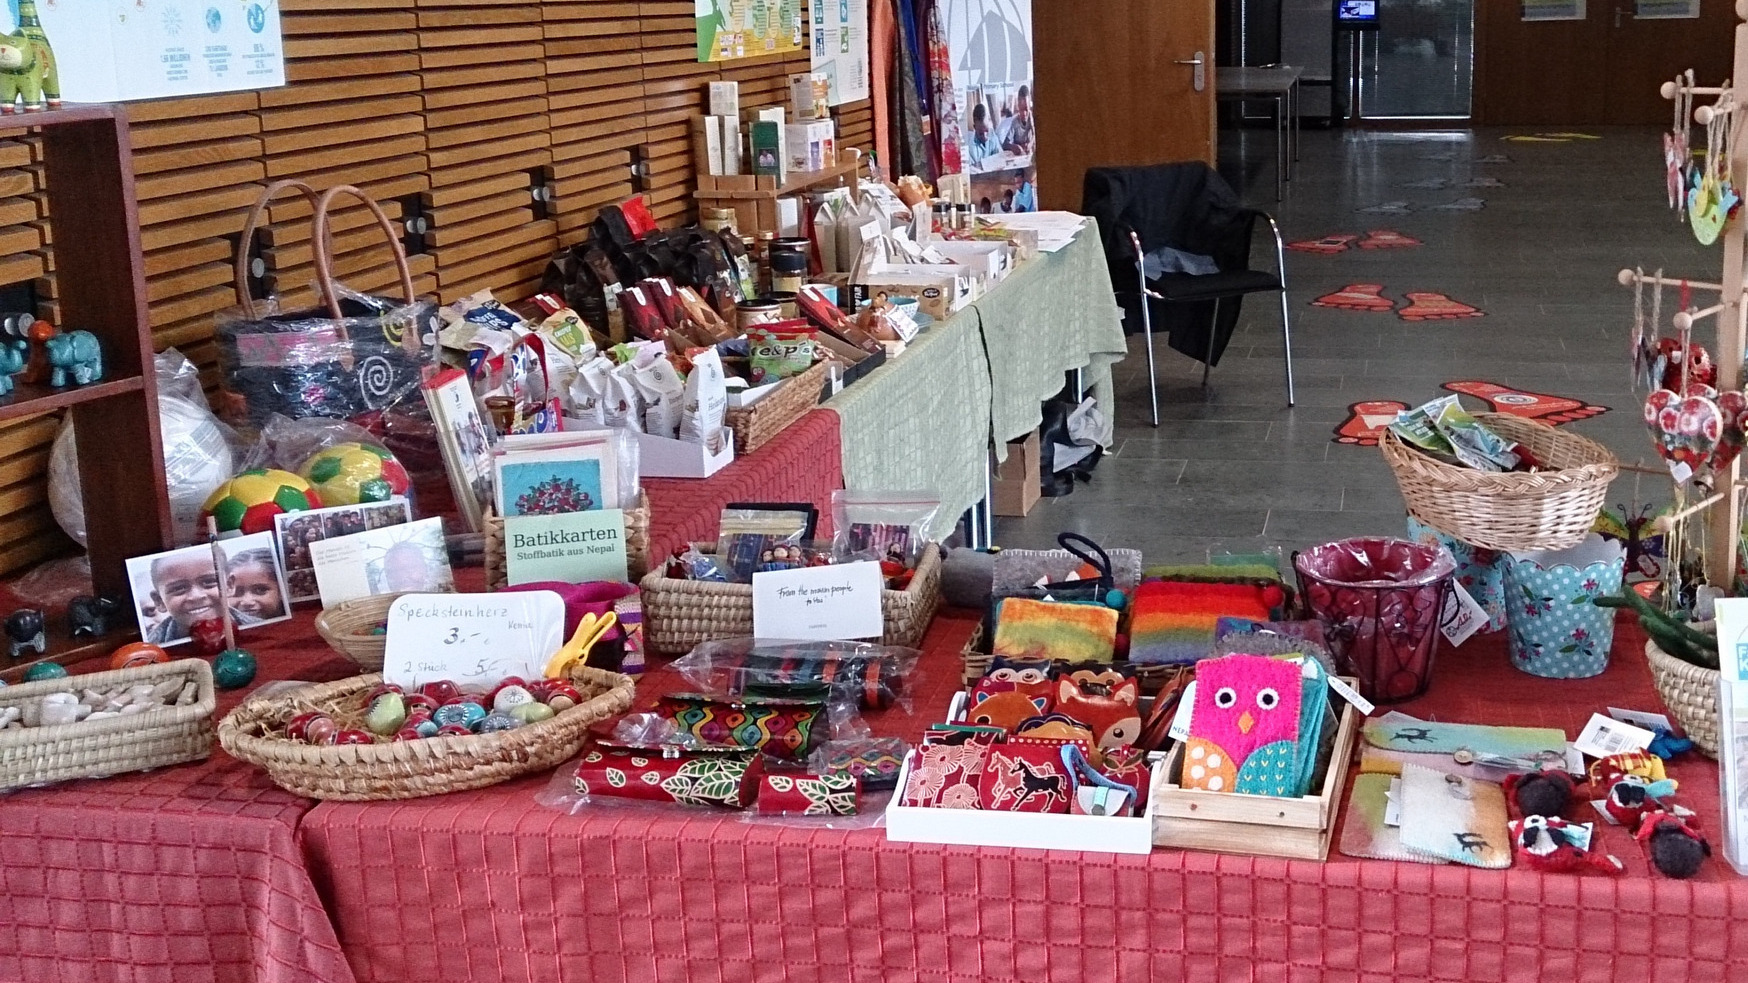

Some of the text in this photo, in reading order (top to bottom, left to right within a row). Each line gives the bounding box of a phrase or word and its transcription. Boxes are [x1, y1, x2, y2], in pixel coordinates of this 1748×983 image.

[513, 528, 618, 548] Batikkarten
[517, 543, 615, 560] Stoffbatik aus Nepal
[777, 586, 796, 599] From
[798, 584, 808, 596] the
[831, 581, 854, 597] people
[399, 603, 508, 621] Specksteinherz
[403, 661, 412, 673] 2
